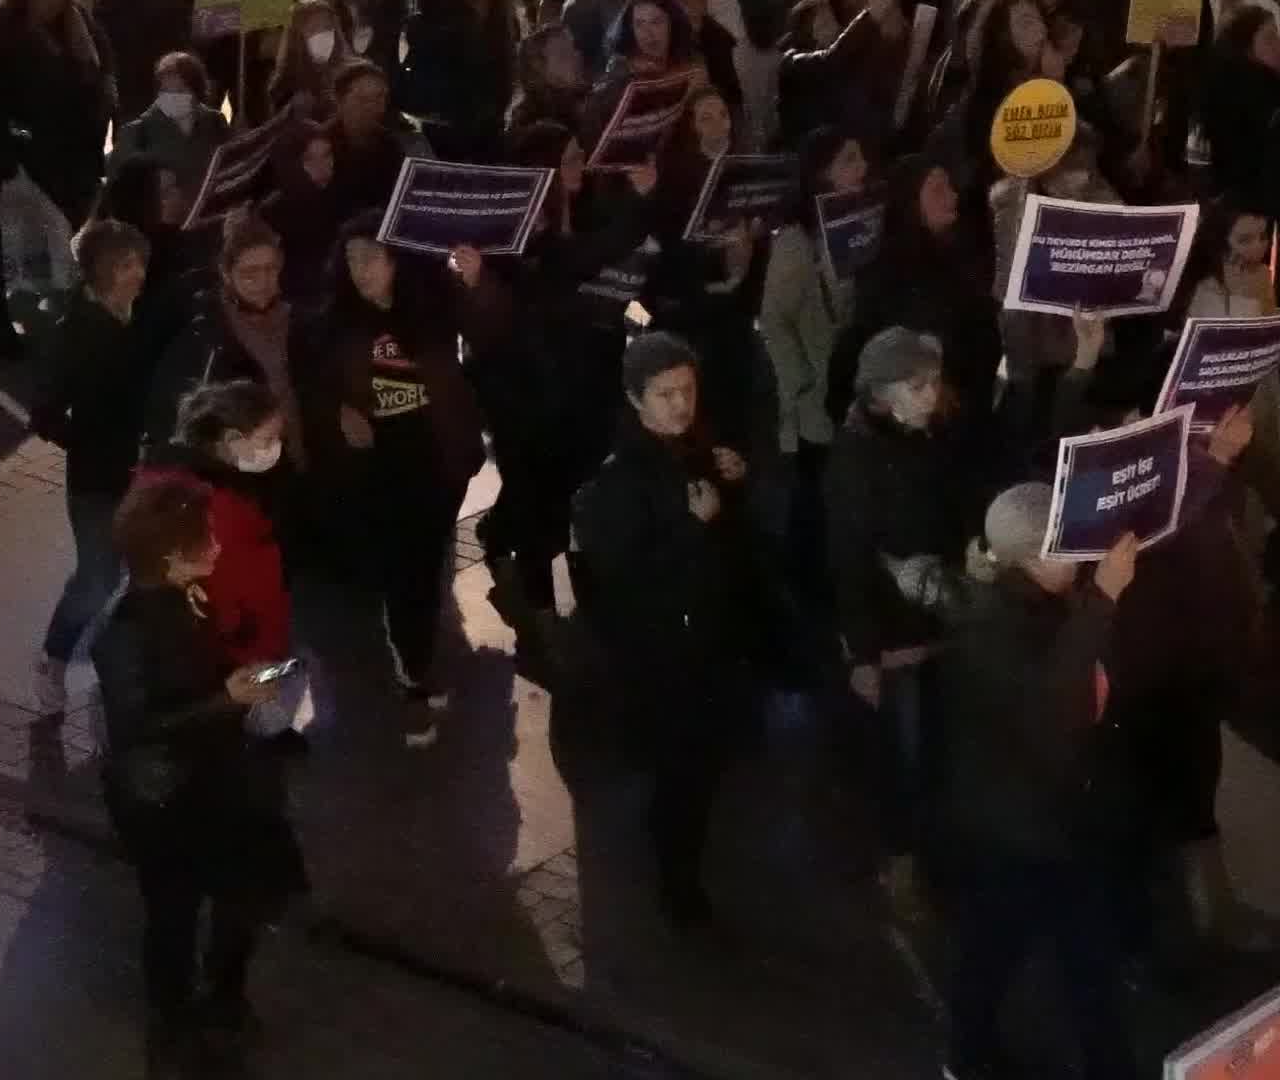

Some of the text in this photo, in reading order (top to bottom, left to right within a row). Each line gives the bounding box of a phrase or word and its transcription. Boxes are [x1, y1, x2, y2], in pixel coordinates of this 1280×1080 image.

[1112, 457, 1154, 485] EŞİT İŞE
[1095, 490, 1126, 512] EŞİT
